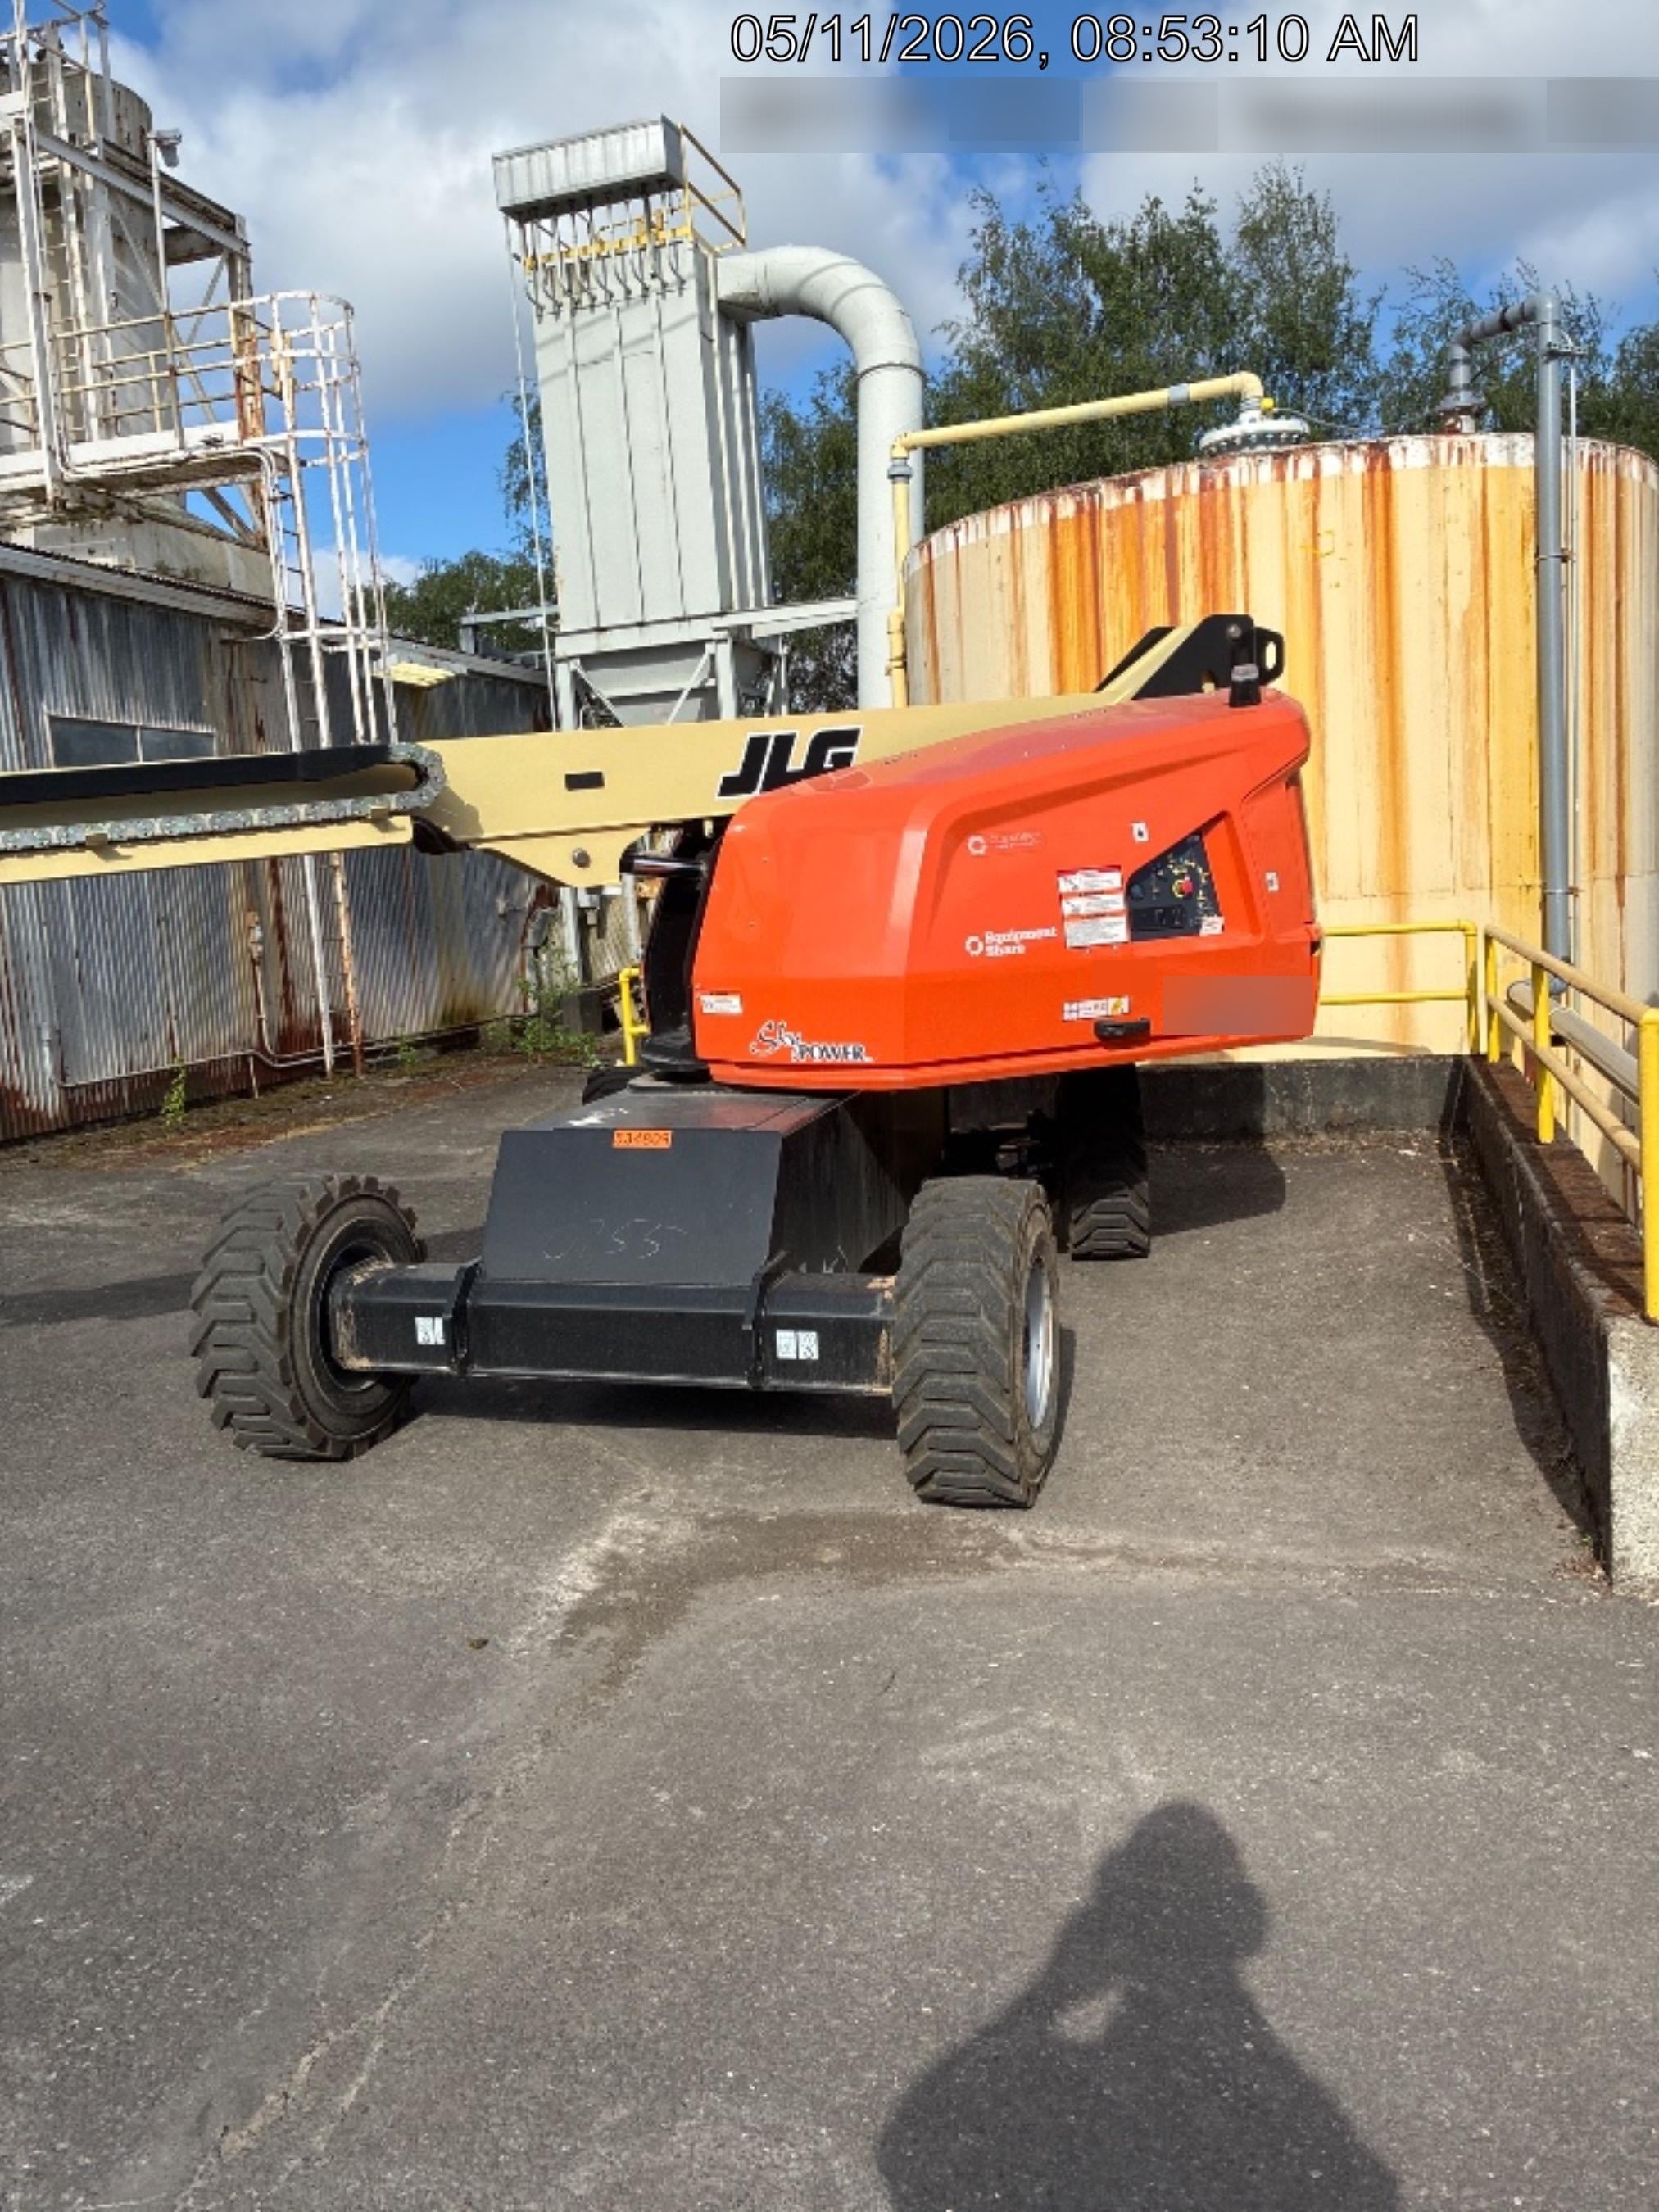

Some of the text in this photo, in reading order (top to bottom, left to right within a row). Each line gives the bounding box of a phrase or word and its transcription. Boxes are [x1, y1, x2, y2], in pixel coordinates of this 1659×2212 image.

[715, 725, 863, 799] JLG
[985, 927, 1058, 945] Equipment
[985, 944, 1026, 958] Share
[798, 1042, 864, 1062] POWER
